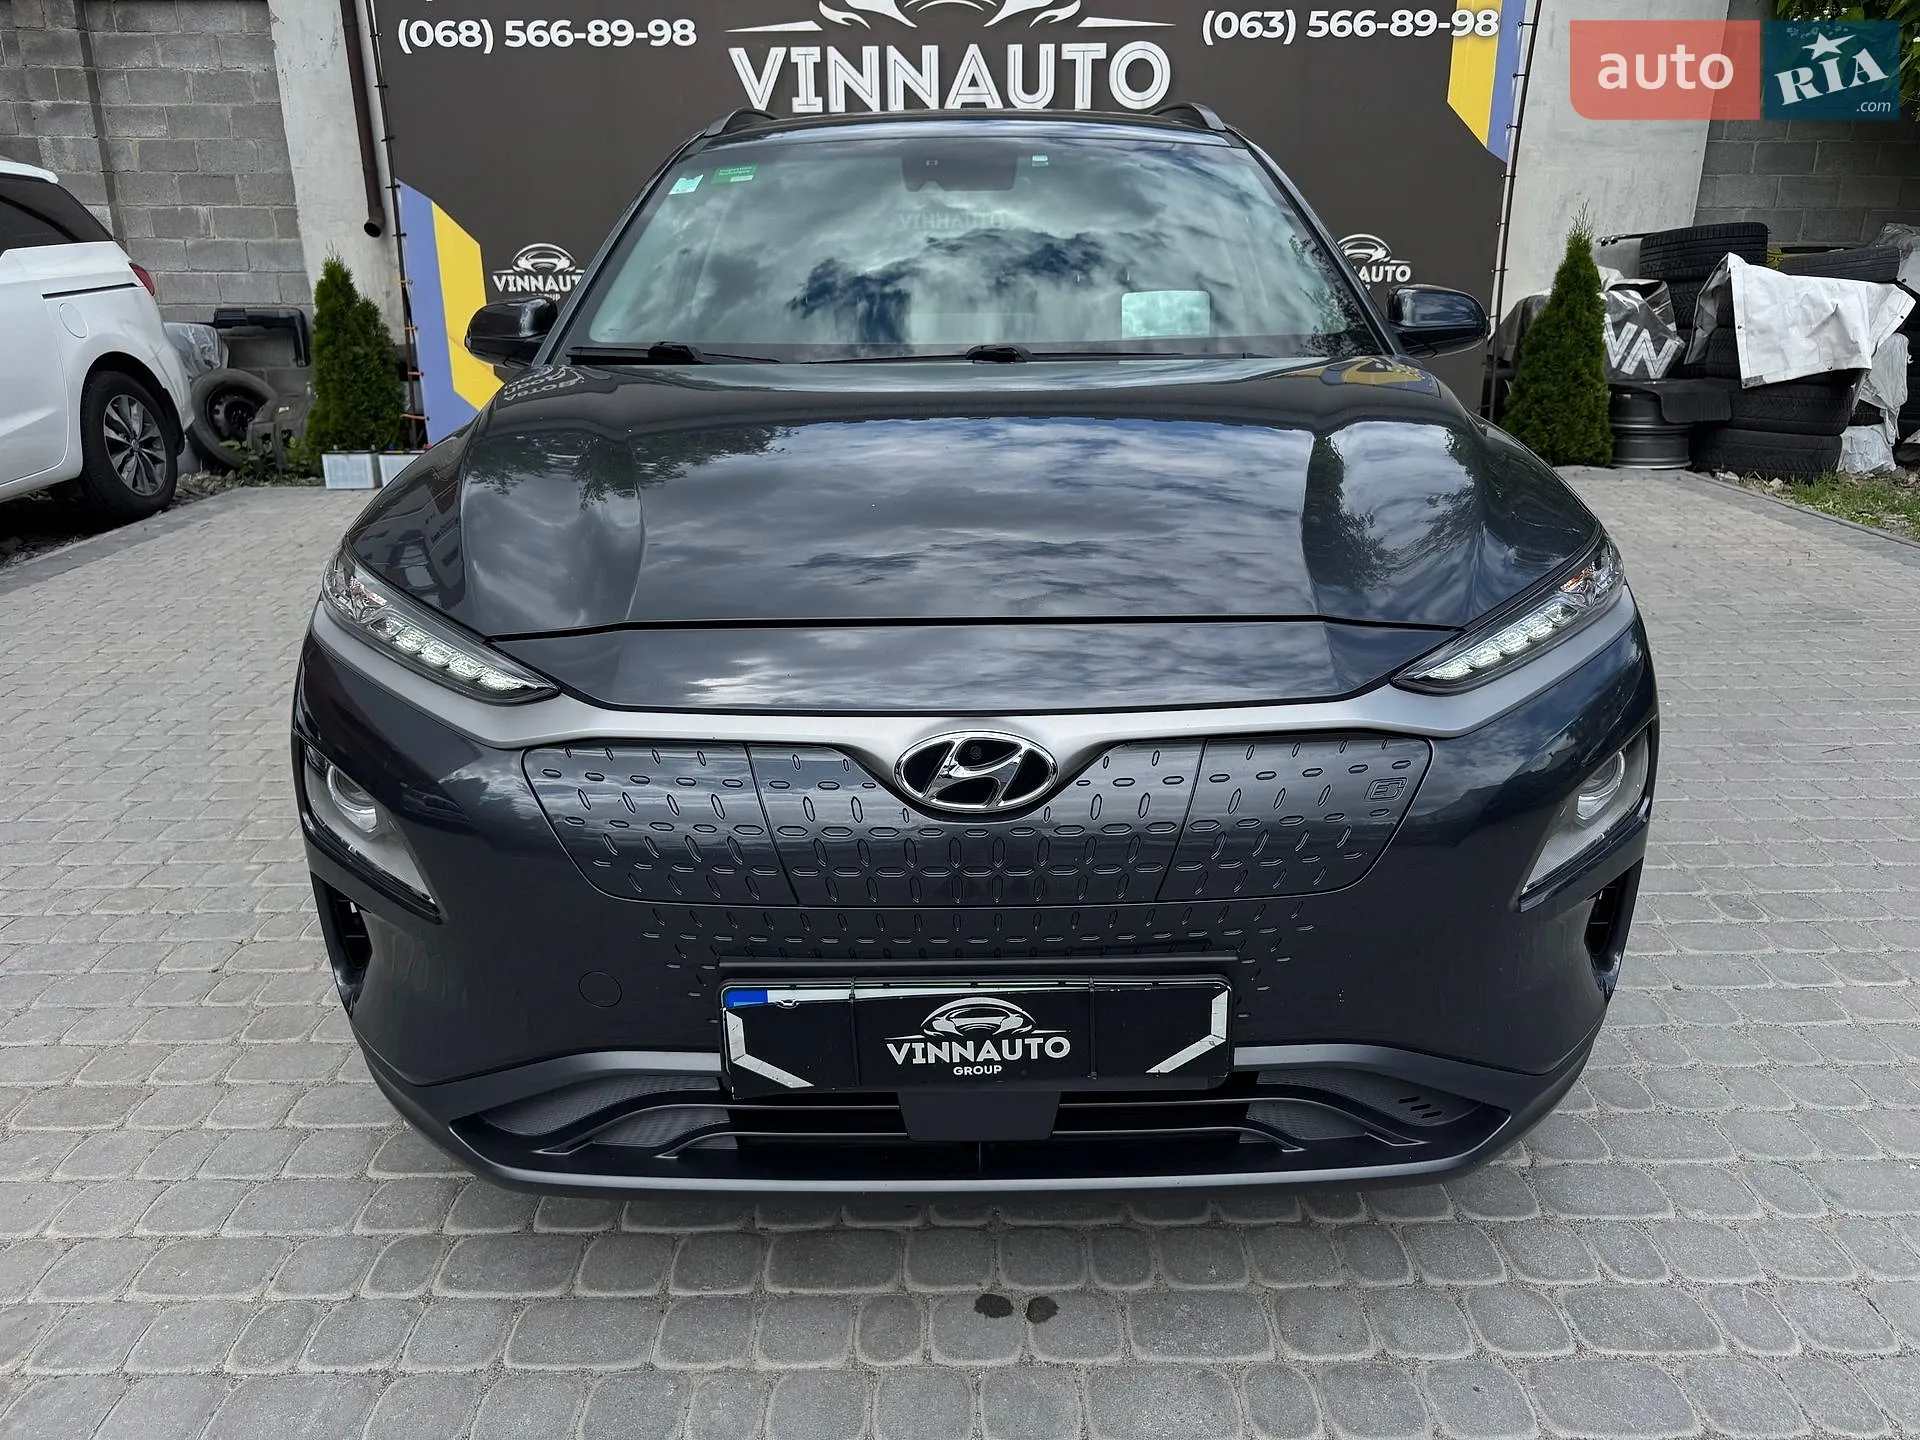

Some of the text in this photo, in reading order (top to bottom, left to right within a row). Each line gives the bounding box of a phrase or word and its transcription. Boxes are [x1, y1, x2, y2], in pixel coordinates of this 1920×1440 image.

[399, 18, 697, 55] (068) 566-89-98
[1202, 9, 1499, 46] (063) 566-89-98
[728, 40, 1172, 112] VINNAUTO
[491, 274, 583, 293] VINNAUT
[1354, 265, 1412, 283] AUTO
[886, 1036, 1071, 1066] VINNAUTO
[953, 1064, 1003, 1076] GROUP
